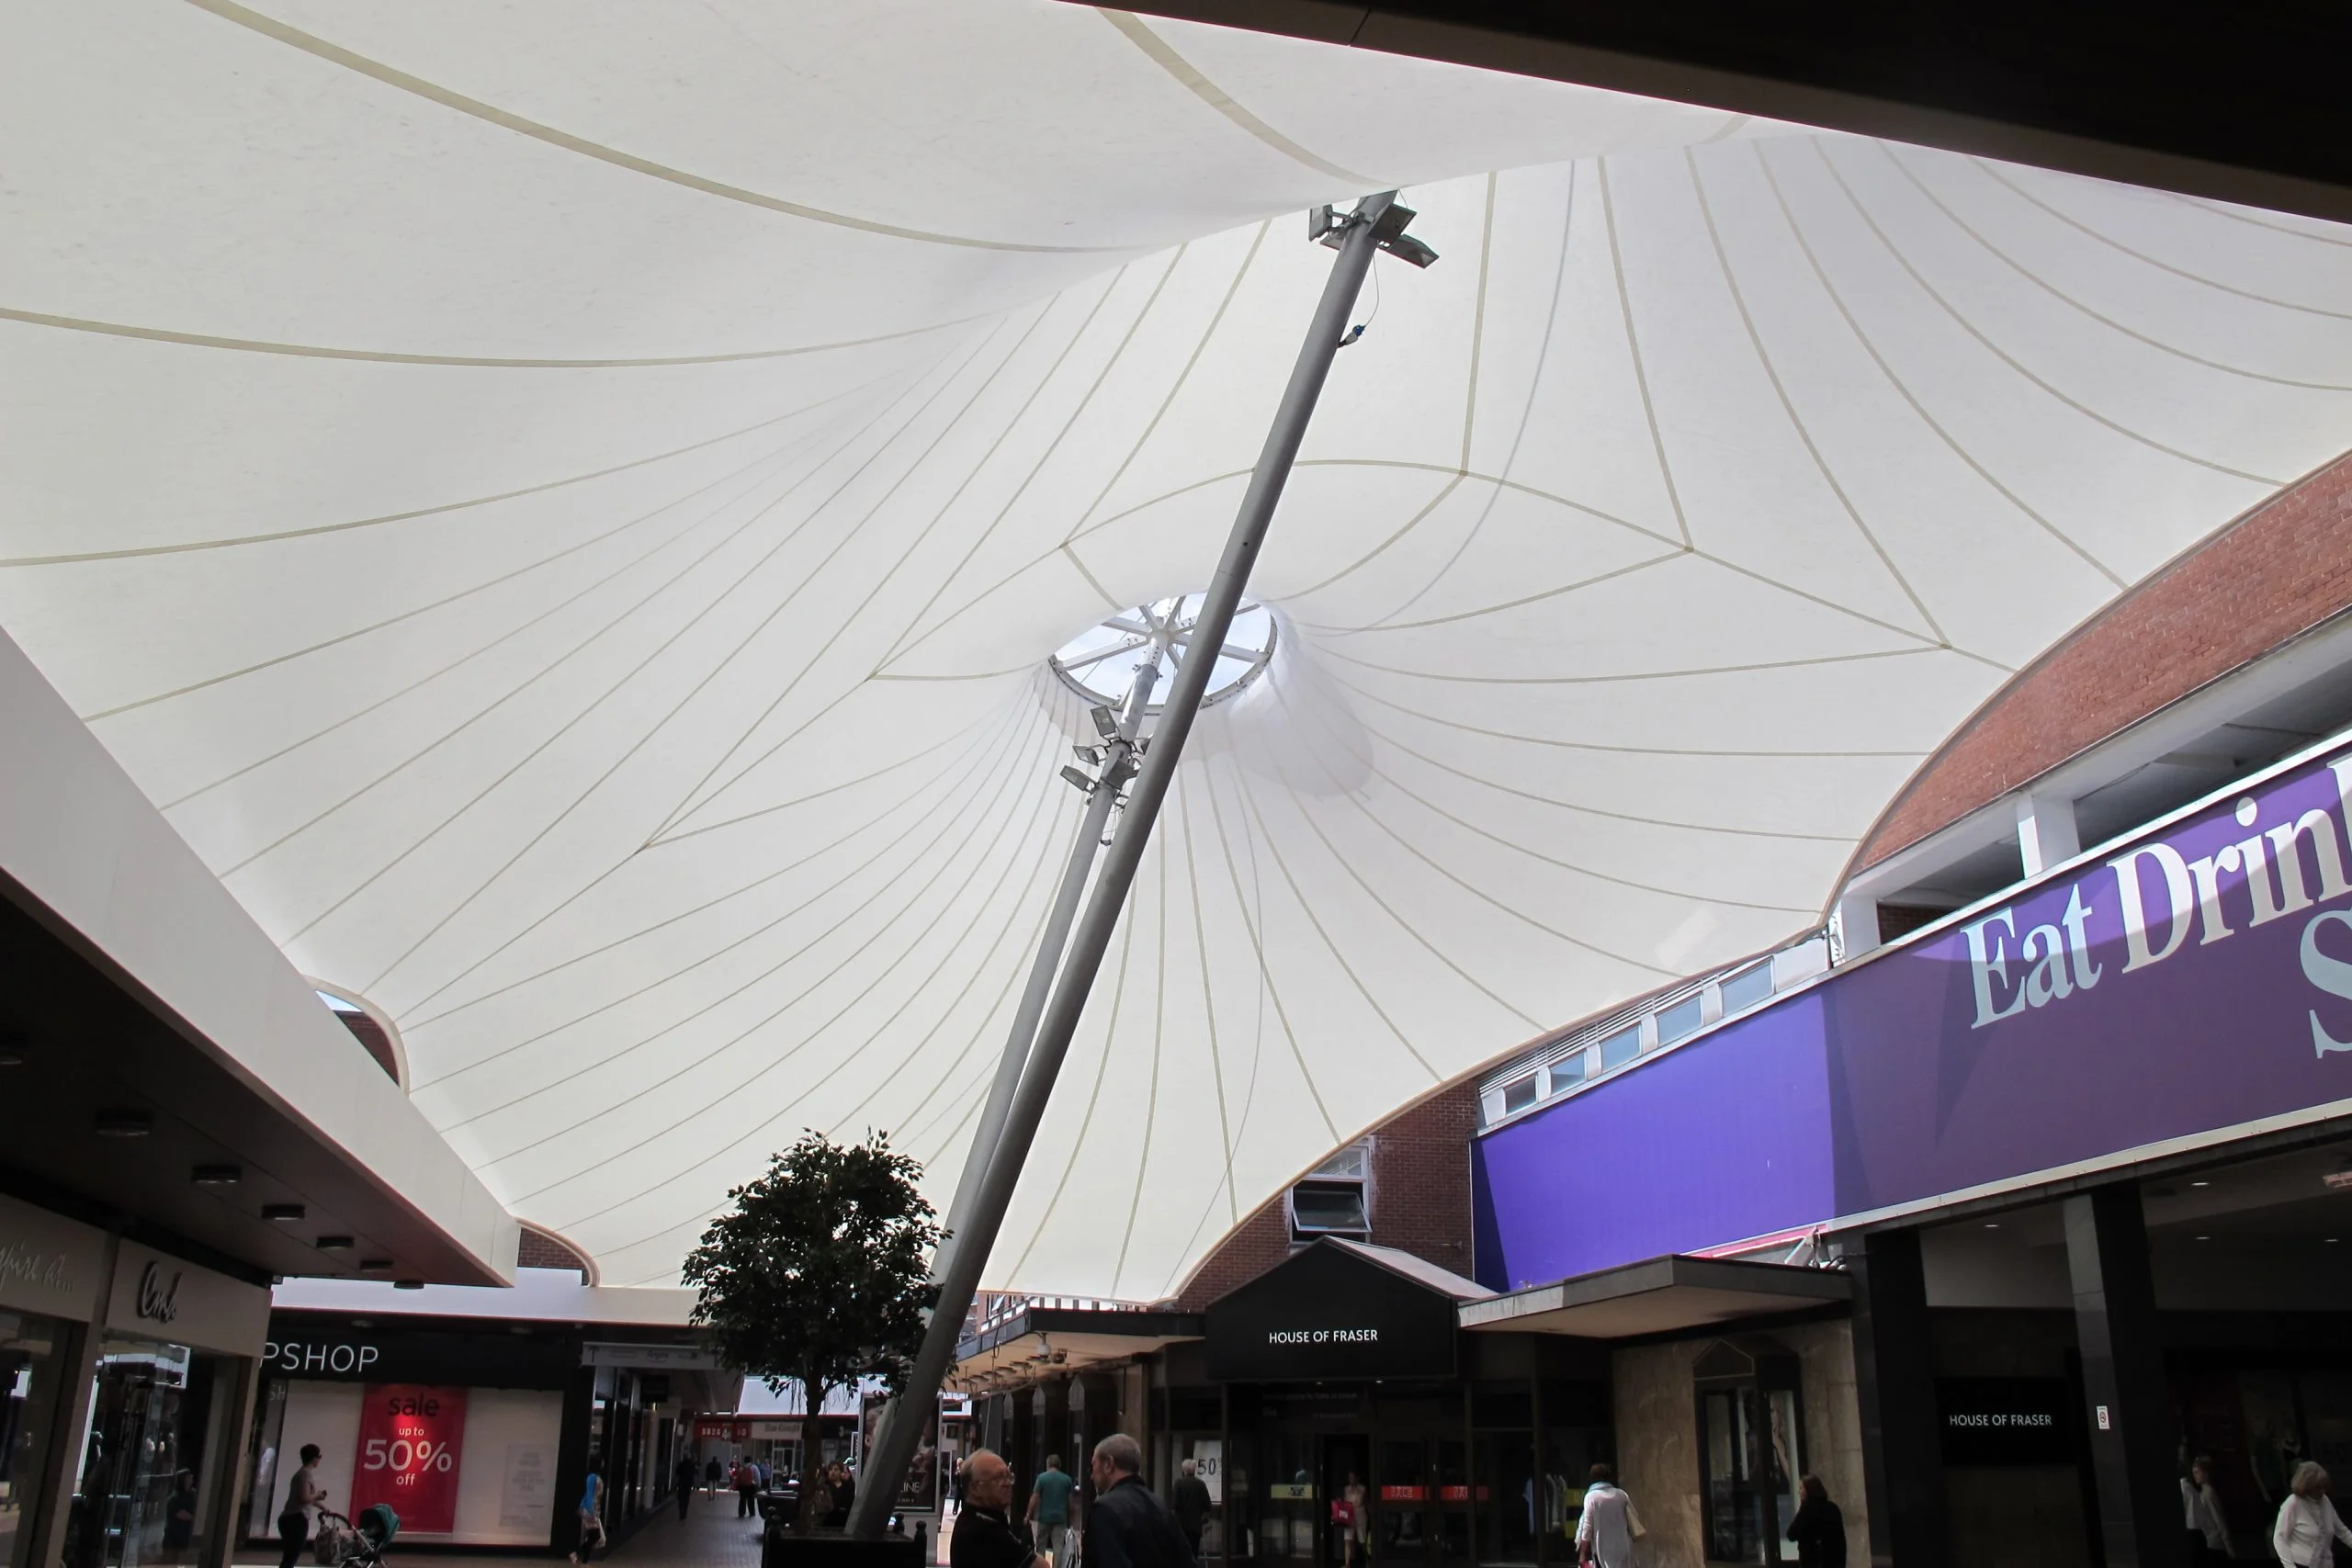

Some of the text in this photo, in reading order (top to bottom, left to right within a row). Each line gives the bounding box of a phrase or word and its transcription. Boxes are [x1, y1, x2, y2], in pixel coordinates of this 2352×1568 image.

[1960, 759, 2352, 1030] Eat Drin
[1269, 1329, 1378, 1344] HOUSE OF FRASER
[388, 1393, 441, 1417] sale
[1950, 1414, 2052, 1426] HOUSE OF FRASER
[399, 1427, 424, 1437] up to
[363, 1439, 452, 1473] 50%
[396, 1473, 416, 1485] off
